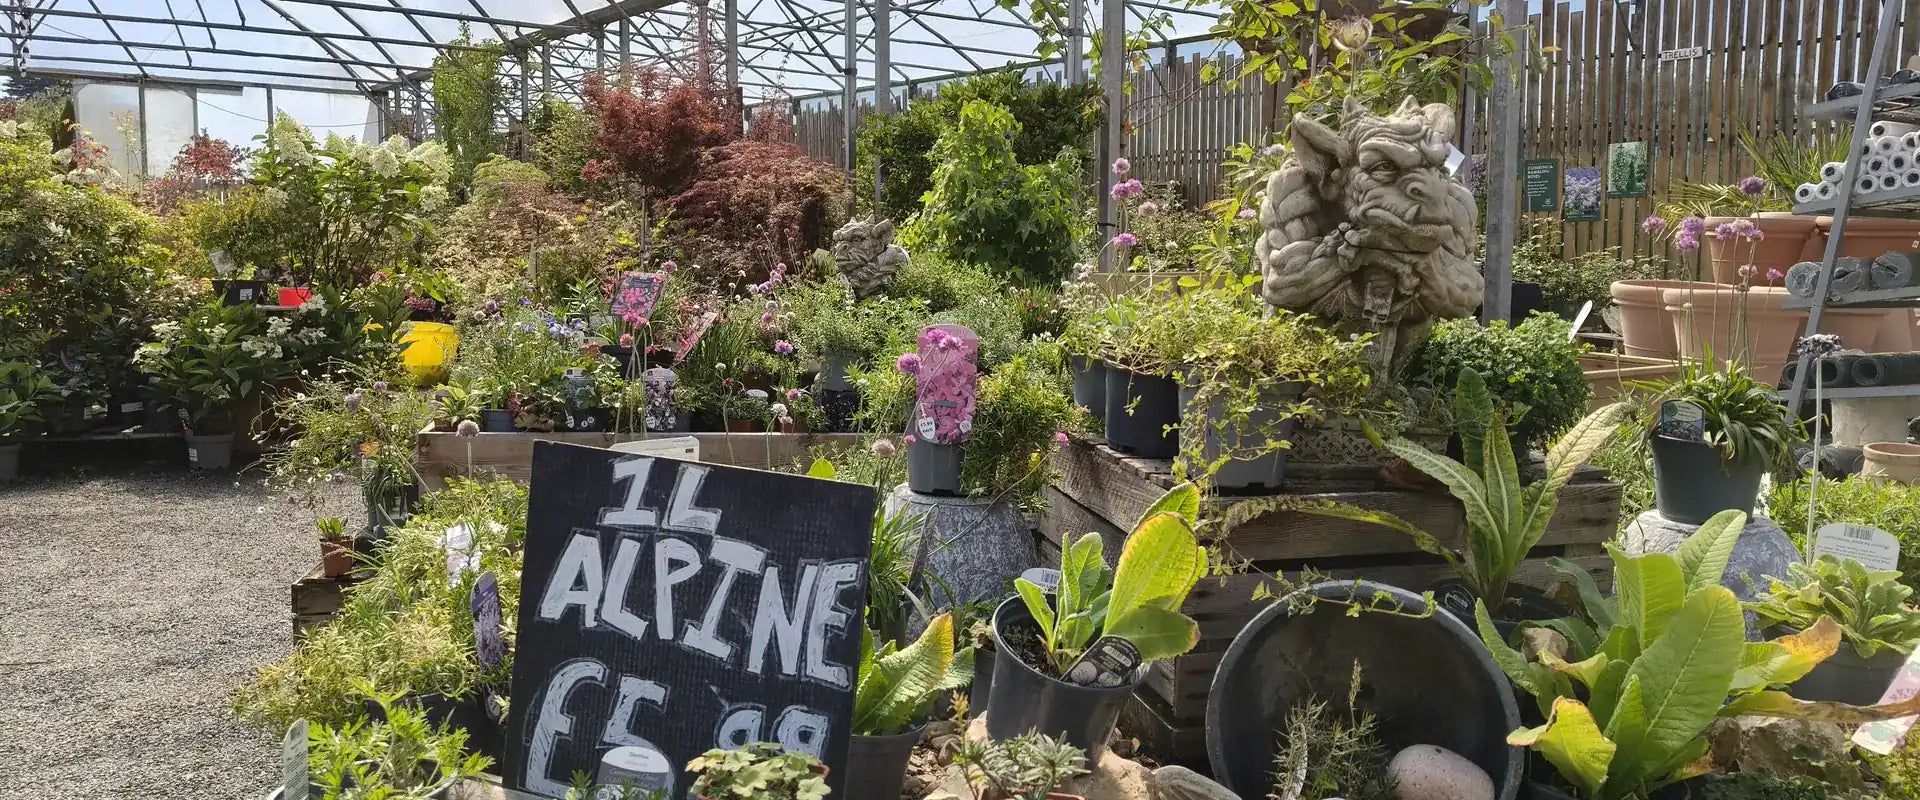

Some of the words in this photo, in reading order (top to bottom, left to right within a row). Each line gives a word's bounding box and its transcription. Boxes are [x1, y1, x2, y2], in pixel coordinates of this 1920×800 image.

[1663, 48, 1699, 60] TRELLIS
[598, 457, 722, 532] 1L
[537, 529, 866, 690] ALPINE
